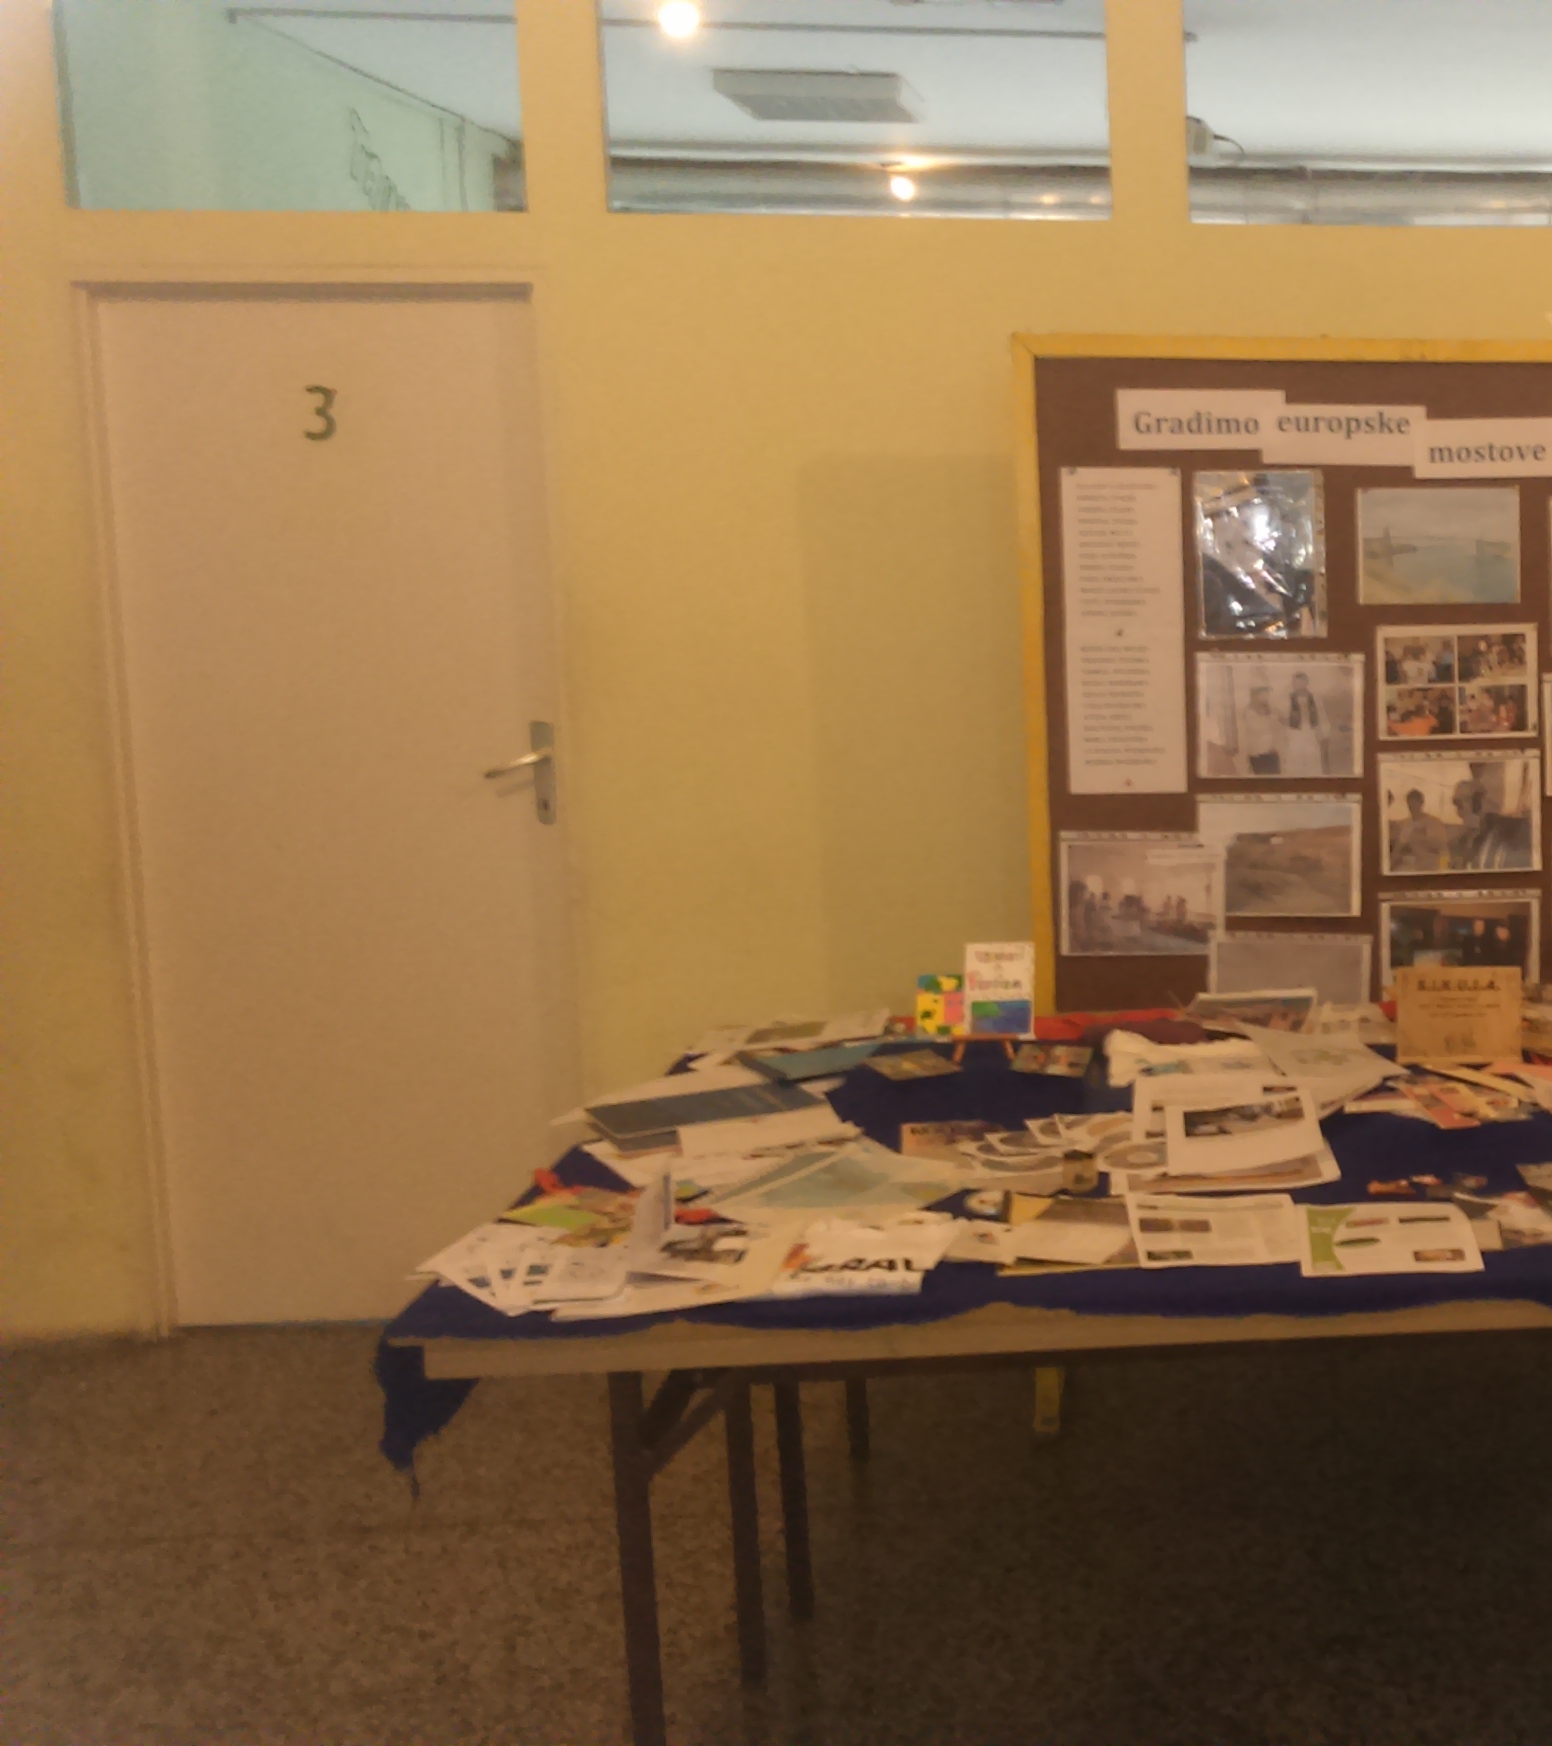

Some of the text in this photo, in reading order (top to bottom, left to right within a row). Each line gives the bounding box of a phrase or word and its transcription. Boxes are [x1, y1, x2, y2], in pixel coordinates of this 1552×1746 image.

[303, 385, 338, 442] 3
[1133, 411, 1260, 435] Gradimo
[1277, 411, 1411, 440] europske
[1429, 442, 1547, 463] mostove
